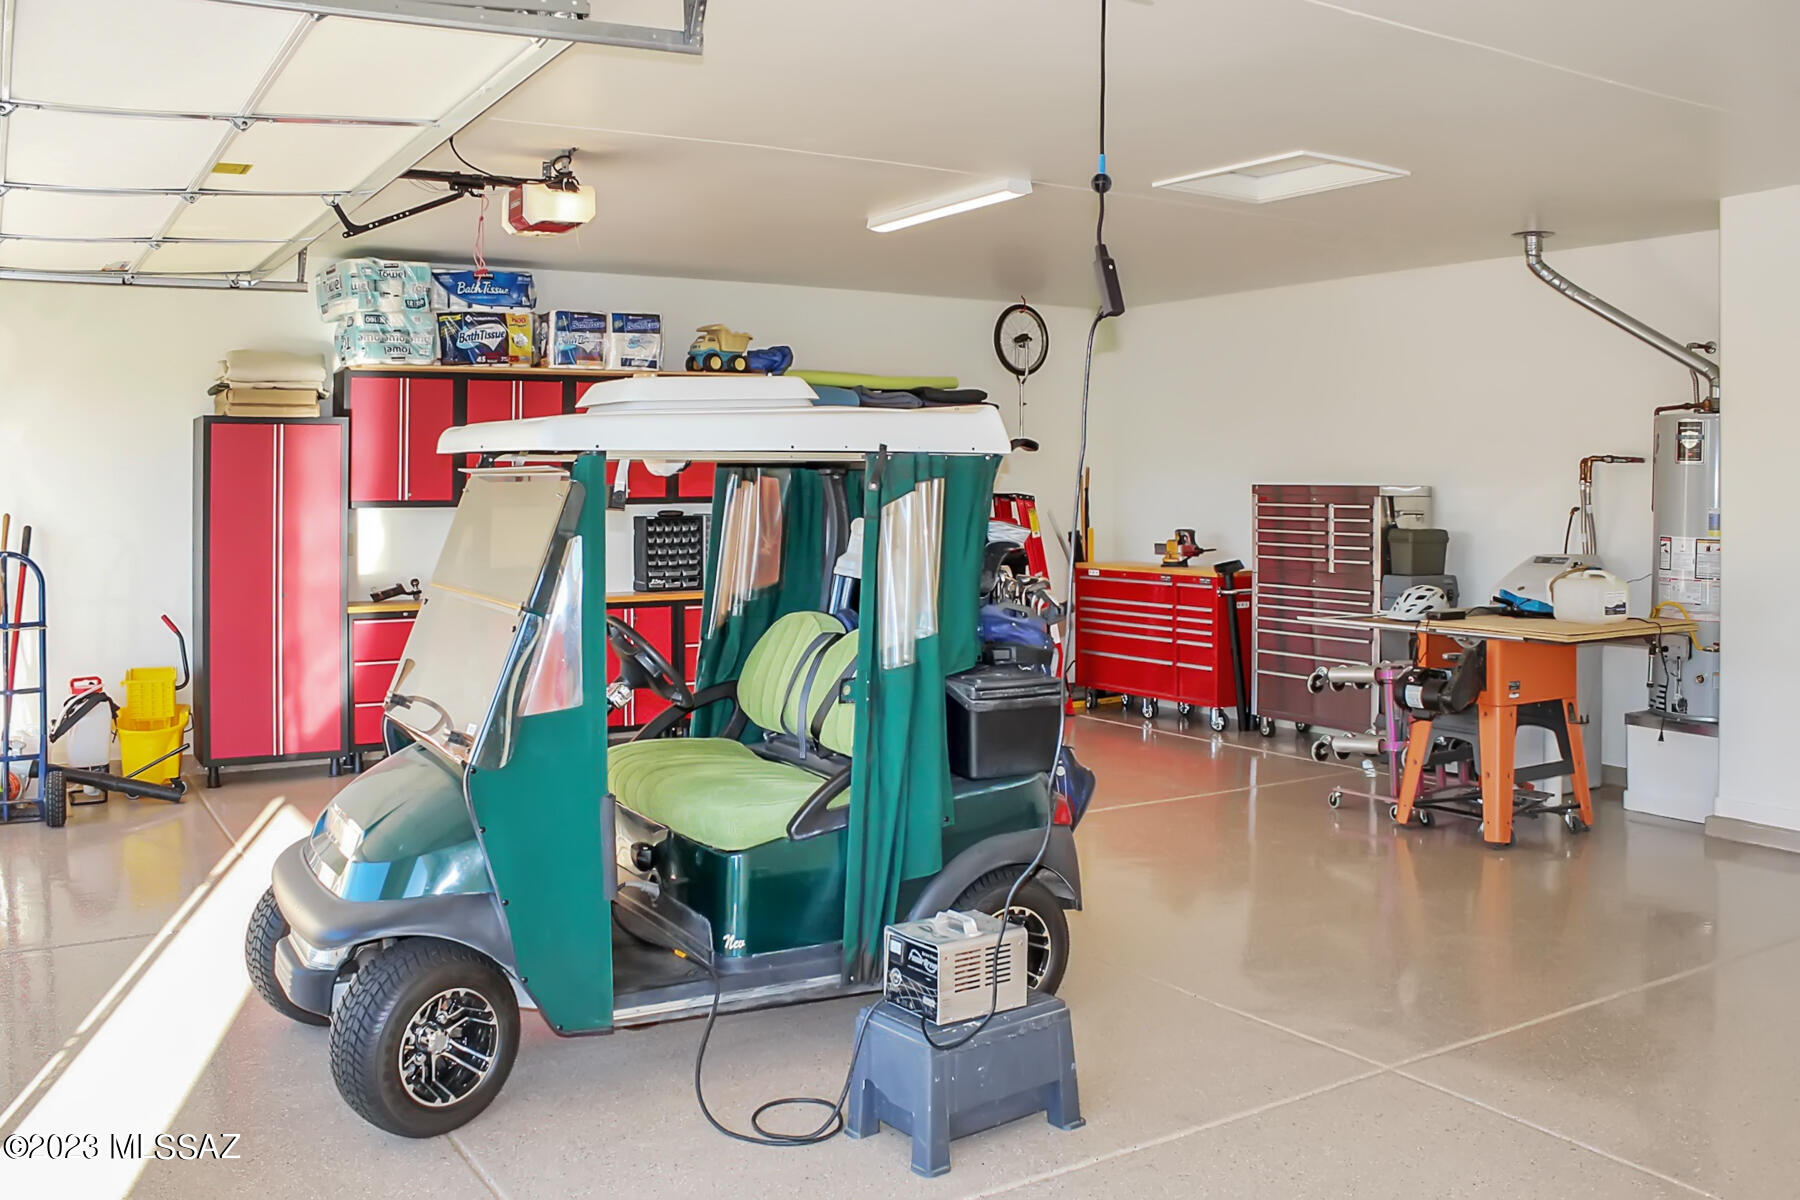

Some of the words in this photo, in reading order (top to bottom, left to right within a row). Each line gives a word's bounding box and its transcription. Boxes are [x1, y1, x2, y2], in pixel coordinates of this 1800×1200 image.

[457, 281, 483, 295] Bath
[483, 281, 510, 294] Tissue
[459, 331, 479, 343] Bath
[479, 329, 505, 341] Tissue
